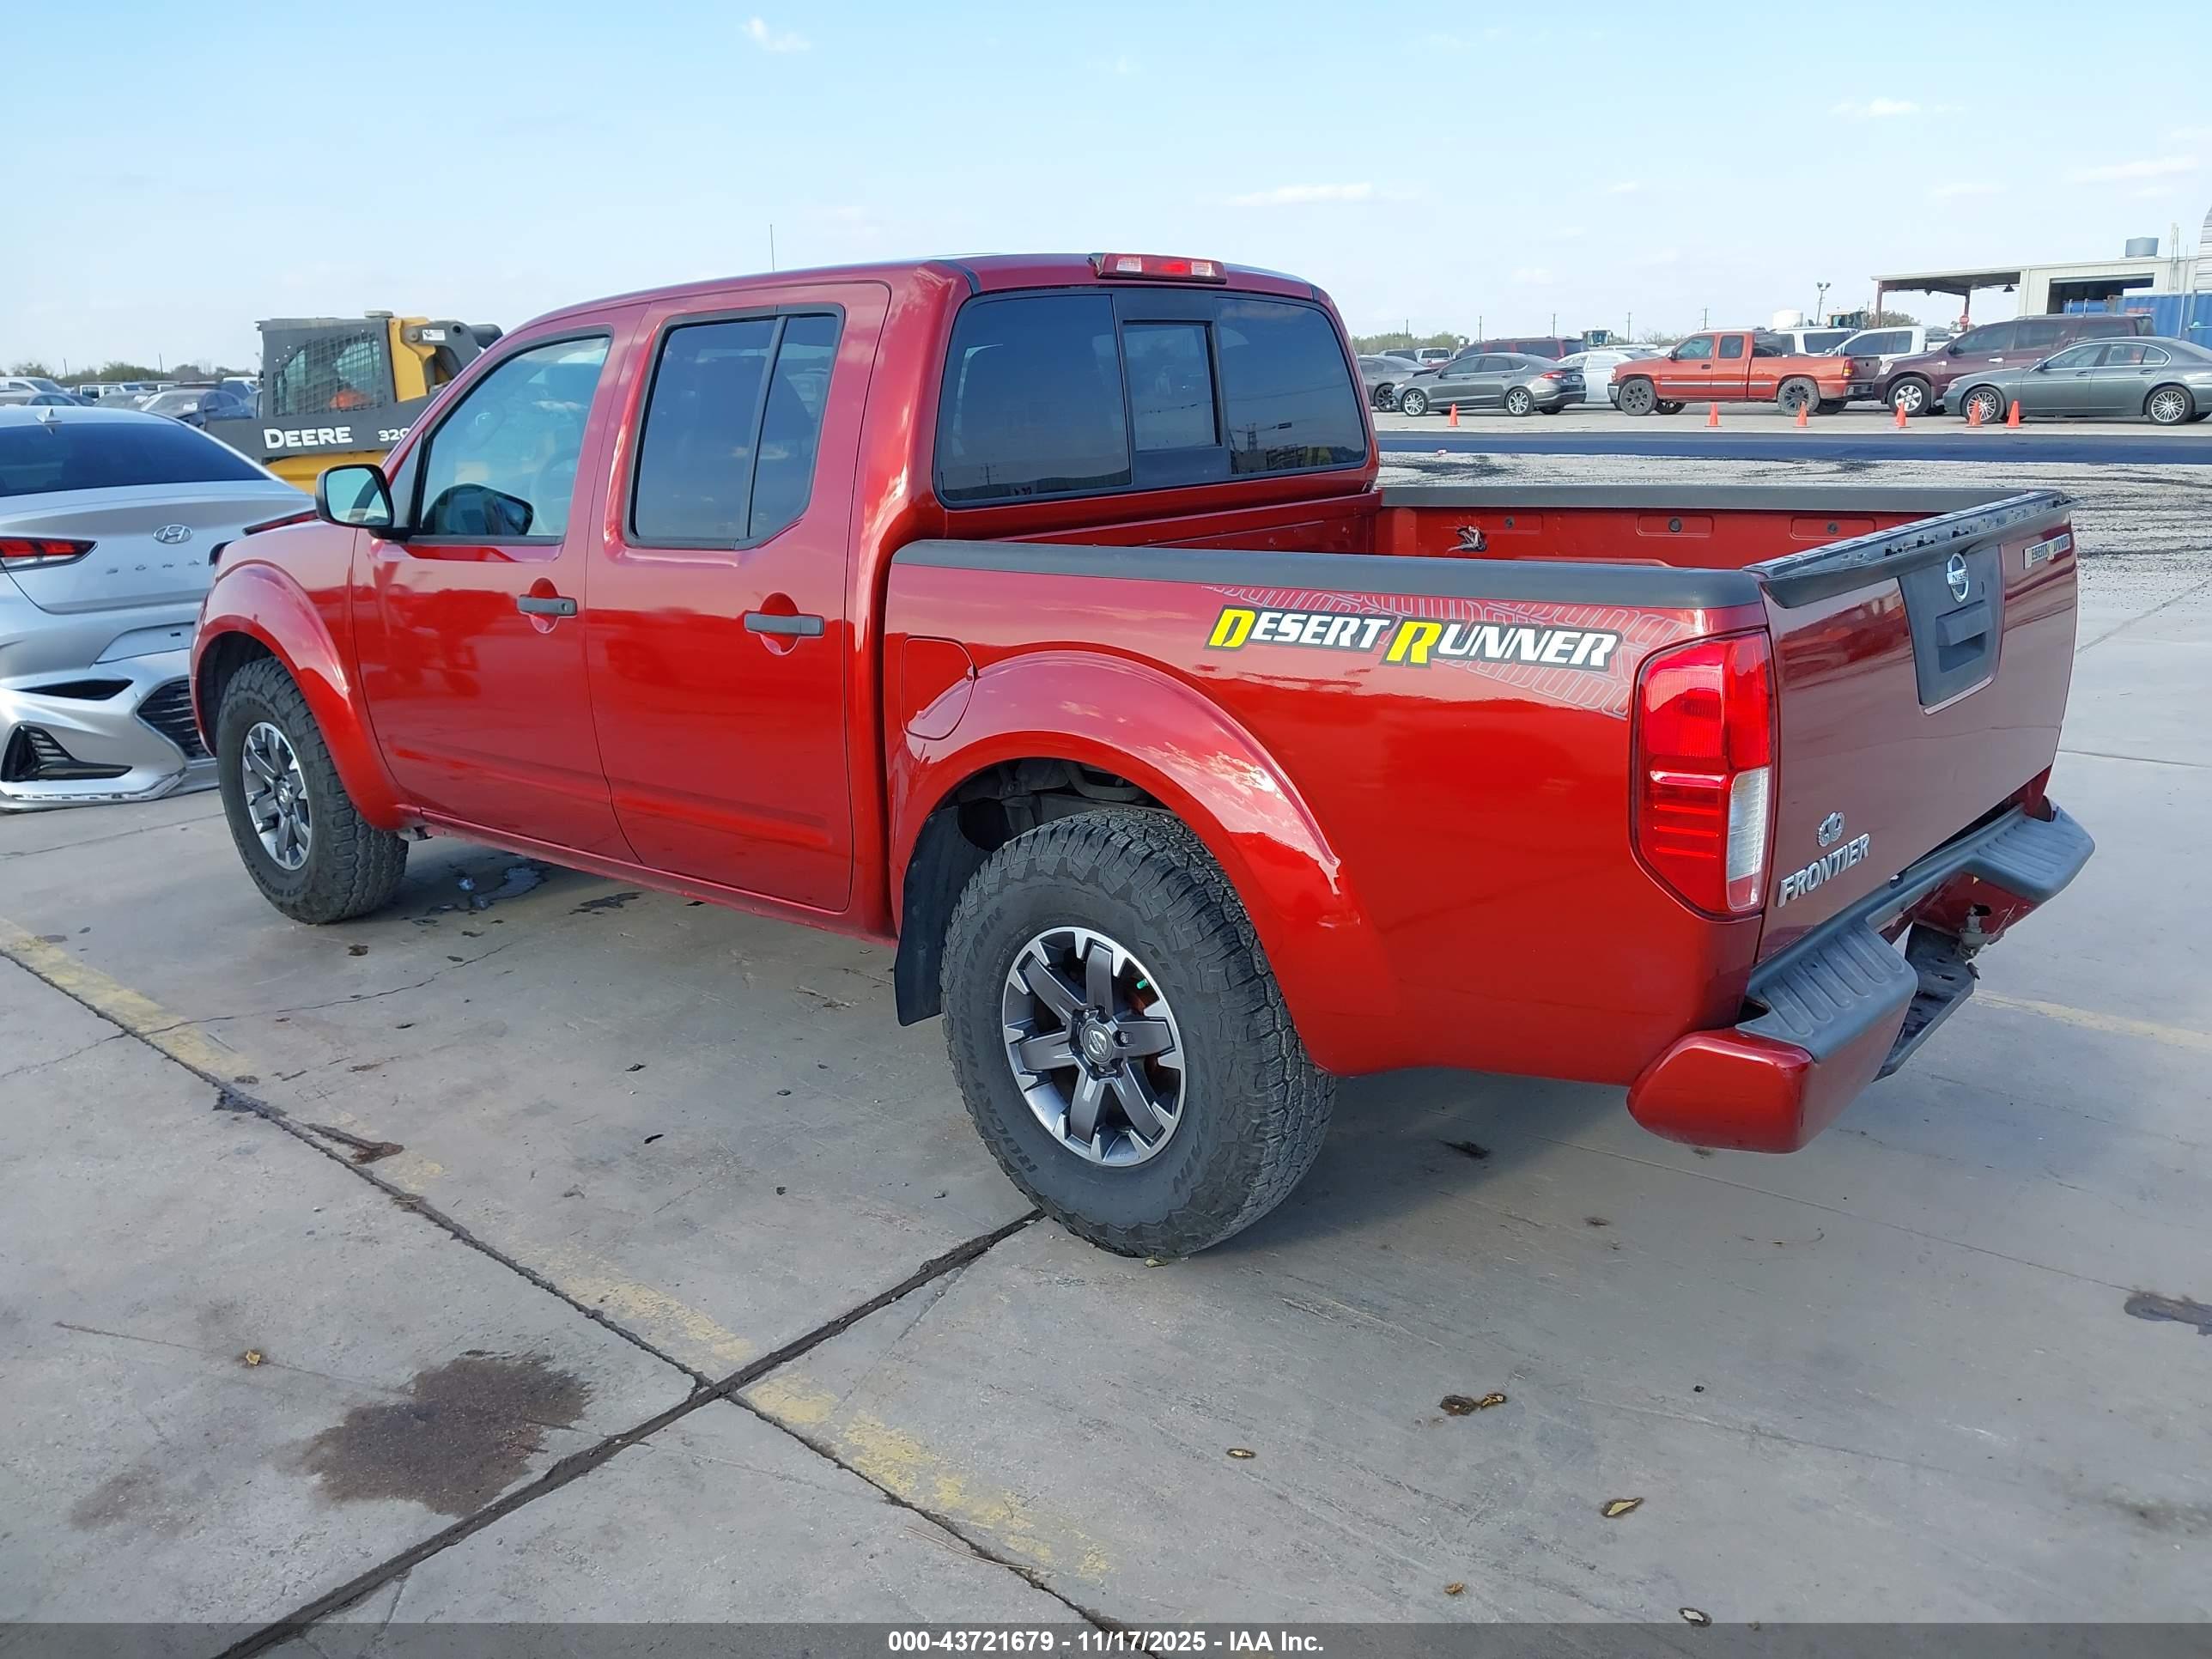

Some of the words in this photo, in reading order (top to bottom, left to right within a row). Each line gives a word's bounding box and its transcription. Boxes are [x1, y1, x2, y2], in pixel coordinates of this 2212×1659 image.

[263, 426, 353, 449] DEERE
[1208, 608, 1391, 649] DESERT
[1386, 621, 1617, 667] RUNNER
[1777, 833, 1870, 908] FRONTIER
